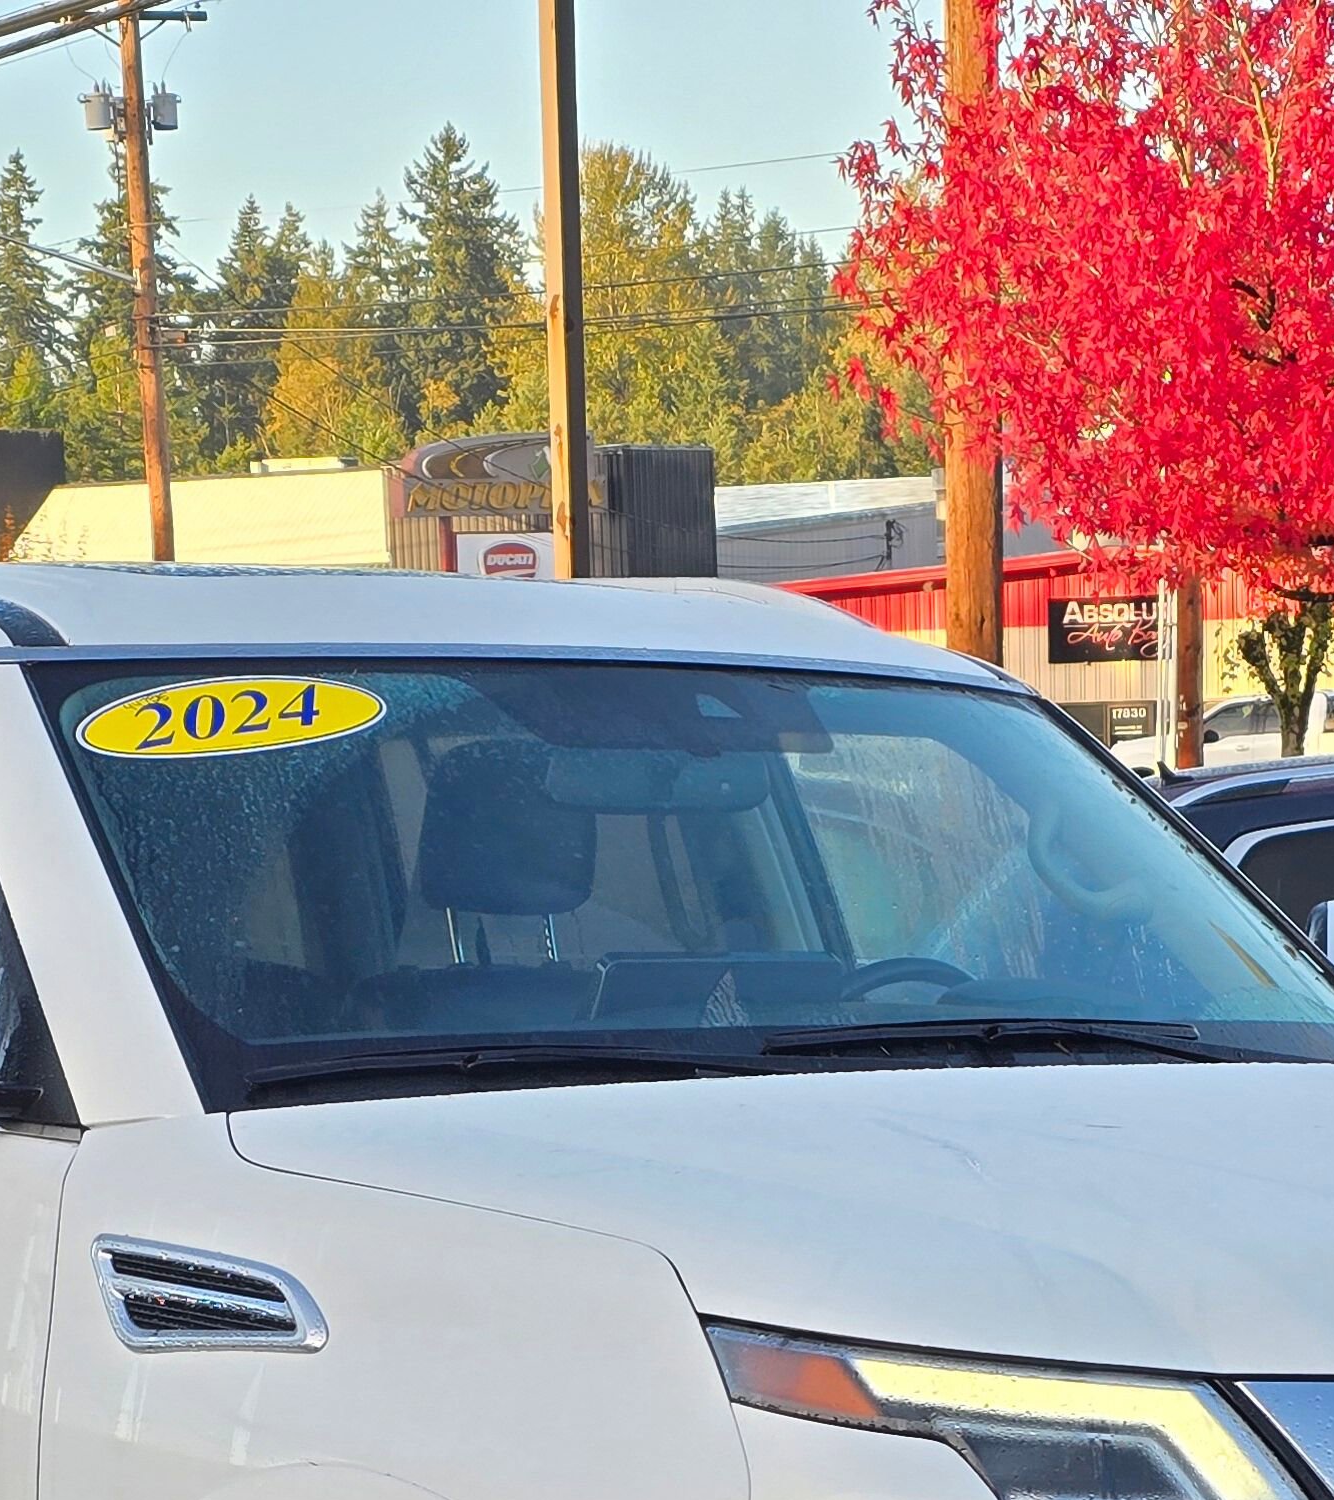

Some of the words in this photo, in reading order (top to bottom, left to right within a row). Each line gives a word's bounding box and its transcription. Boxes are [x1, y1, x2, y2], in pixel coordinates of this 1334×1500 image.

[487, 553, 533, 566] DUCATI
[1062, 601, 1170, 623] ABSOLU
[1067, 623, 1124, 651] Auto
[134, 684, 319, 750] 2024
[1112, 707, 1147, 719] 17830
